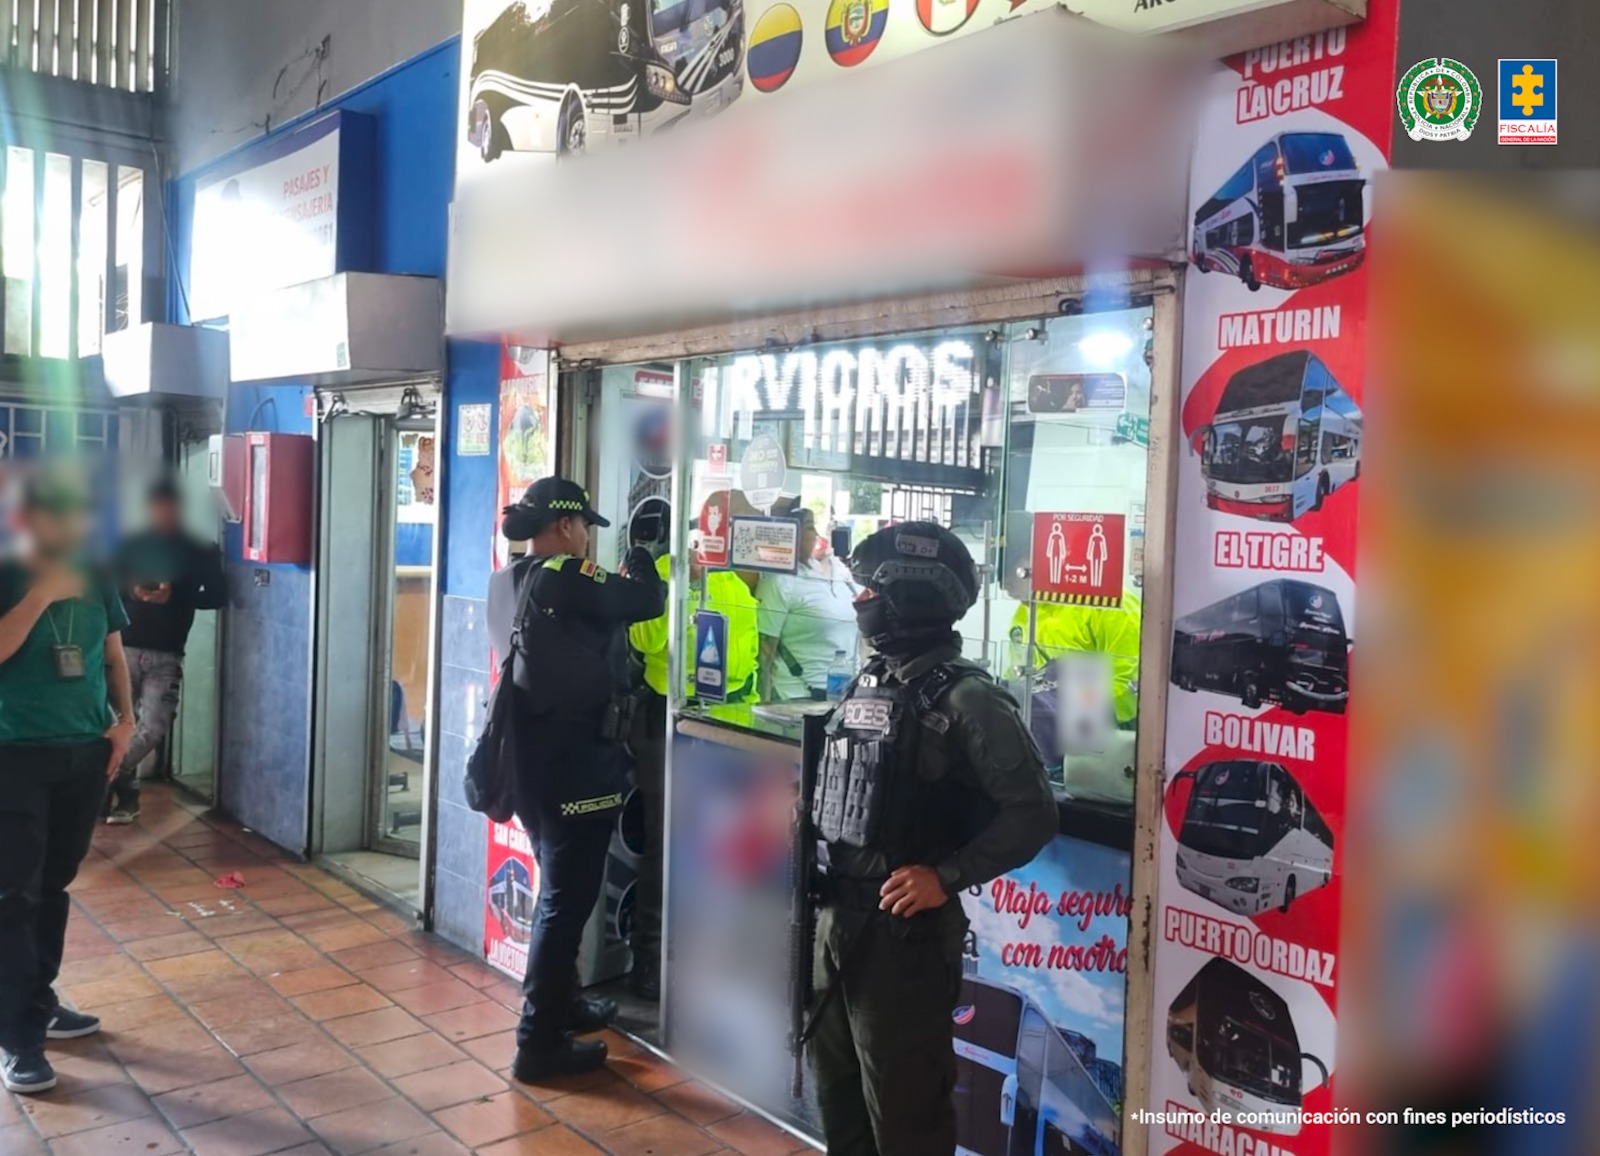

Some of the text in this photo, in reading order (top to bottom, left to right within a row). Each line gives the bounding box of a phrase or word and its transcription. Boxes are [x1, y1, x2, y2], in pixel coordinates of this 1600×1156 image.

[1238, 66, 1345, 123] LA CRUZ
[283, 164, 330, 200] PASAJES Y
[1219, 305, 1341, 349] MATURIN
[1068, 514, 1104, 523] SEGURIDAD
[1216, 533, 1323, 570] EL TIGRE
[1206, 713, 1316, 761] BOLIVAR
[1002, 942, 1044, 967] con
[1166, 908, 1335, 987] PUERTO ORDAZ
